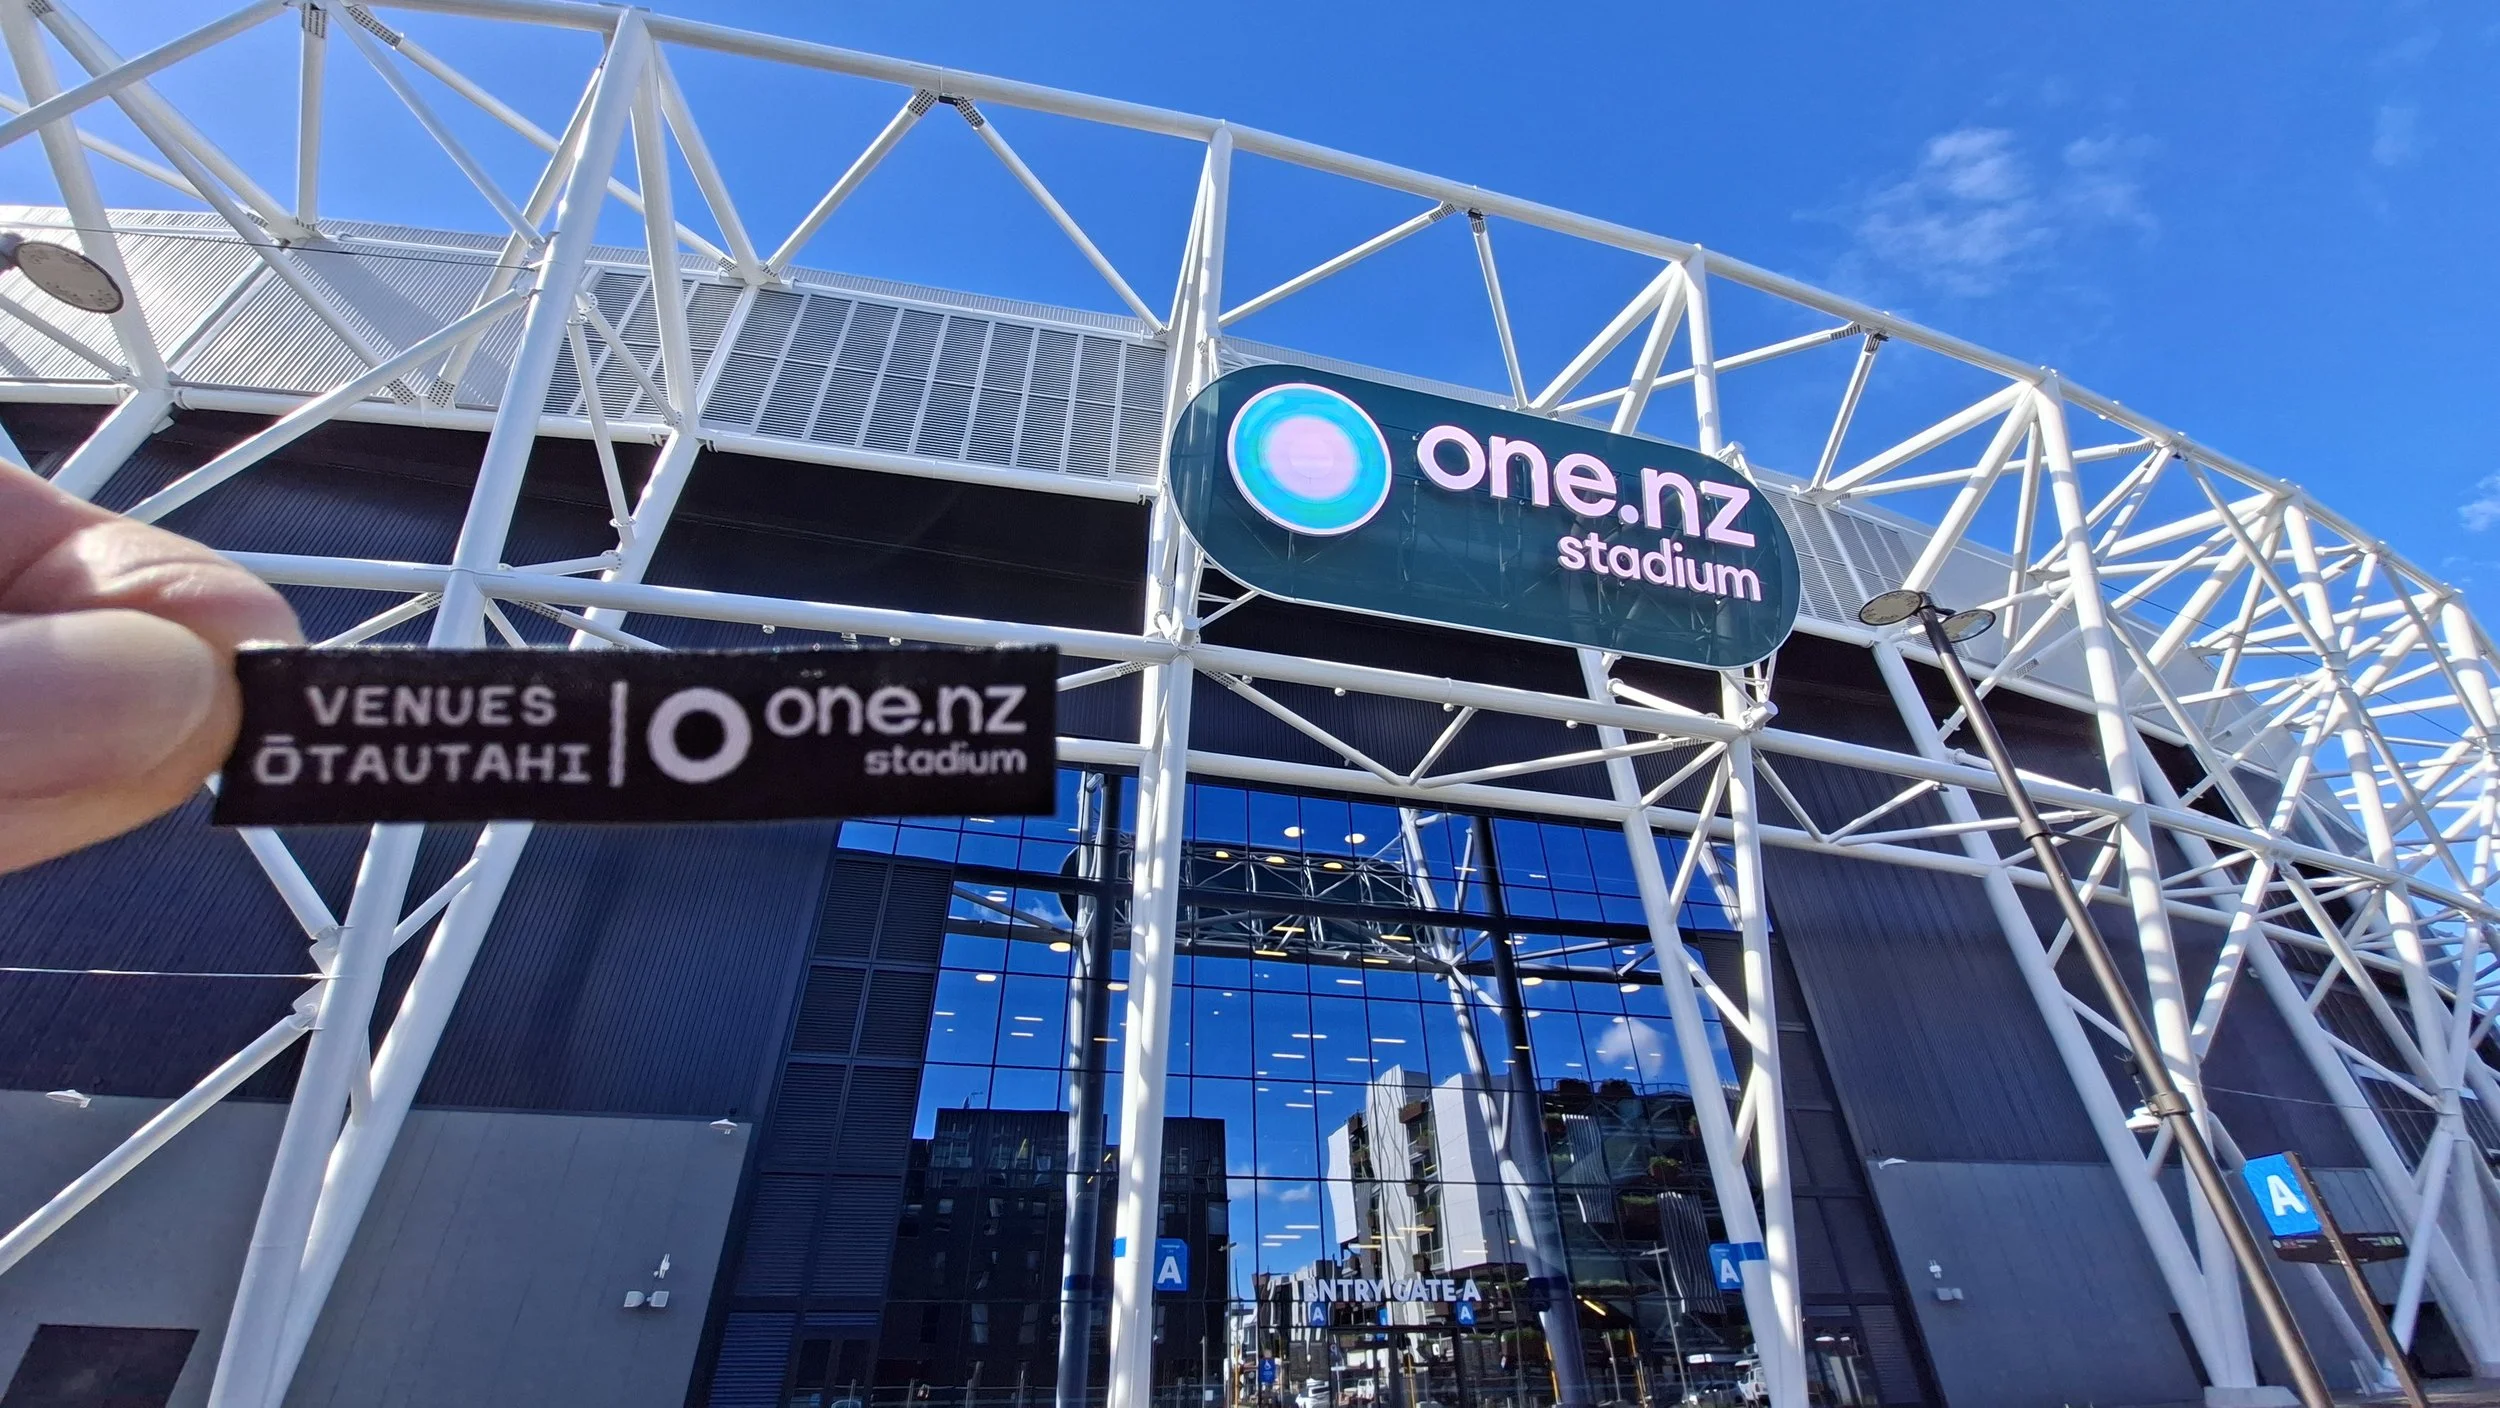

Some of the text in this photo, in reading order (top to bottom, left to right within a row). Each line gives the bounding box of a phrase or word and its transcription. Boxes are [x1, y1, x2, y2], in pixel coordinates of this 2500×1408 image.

[1417, 425, 1756, 547] one.nz
[1557, 531, 1762, 602] stadium
[307, 685, 557, 727] VENUES
[765, 684, 1027, 736] one.nz
[253, 733, 592, 785] ŌTAUTAHI
[864, 746, 1027, 775] stadium
[2267, 1174, 2307, 1217] A
[1157, 1256, 1182, 1284] A
[1302, 1279, 1481, 1302] ENTRY GATE A
[1720, 1258, 1740, 1283] A
[1312, 1306, 1325, 1322] A
